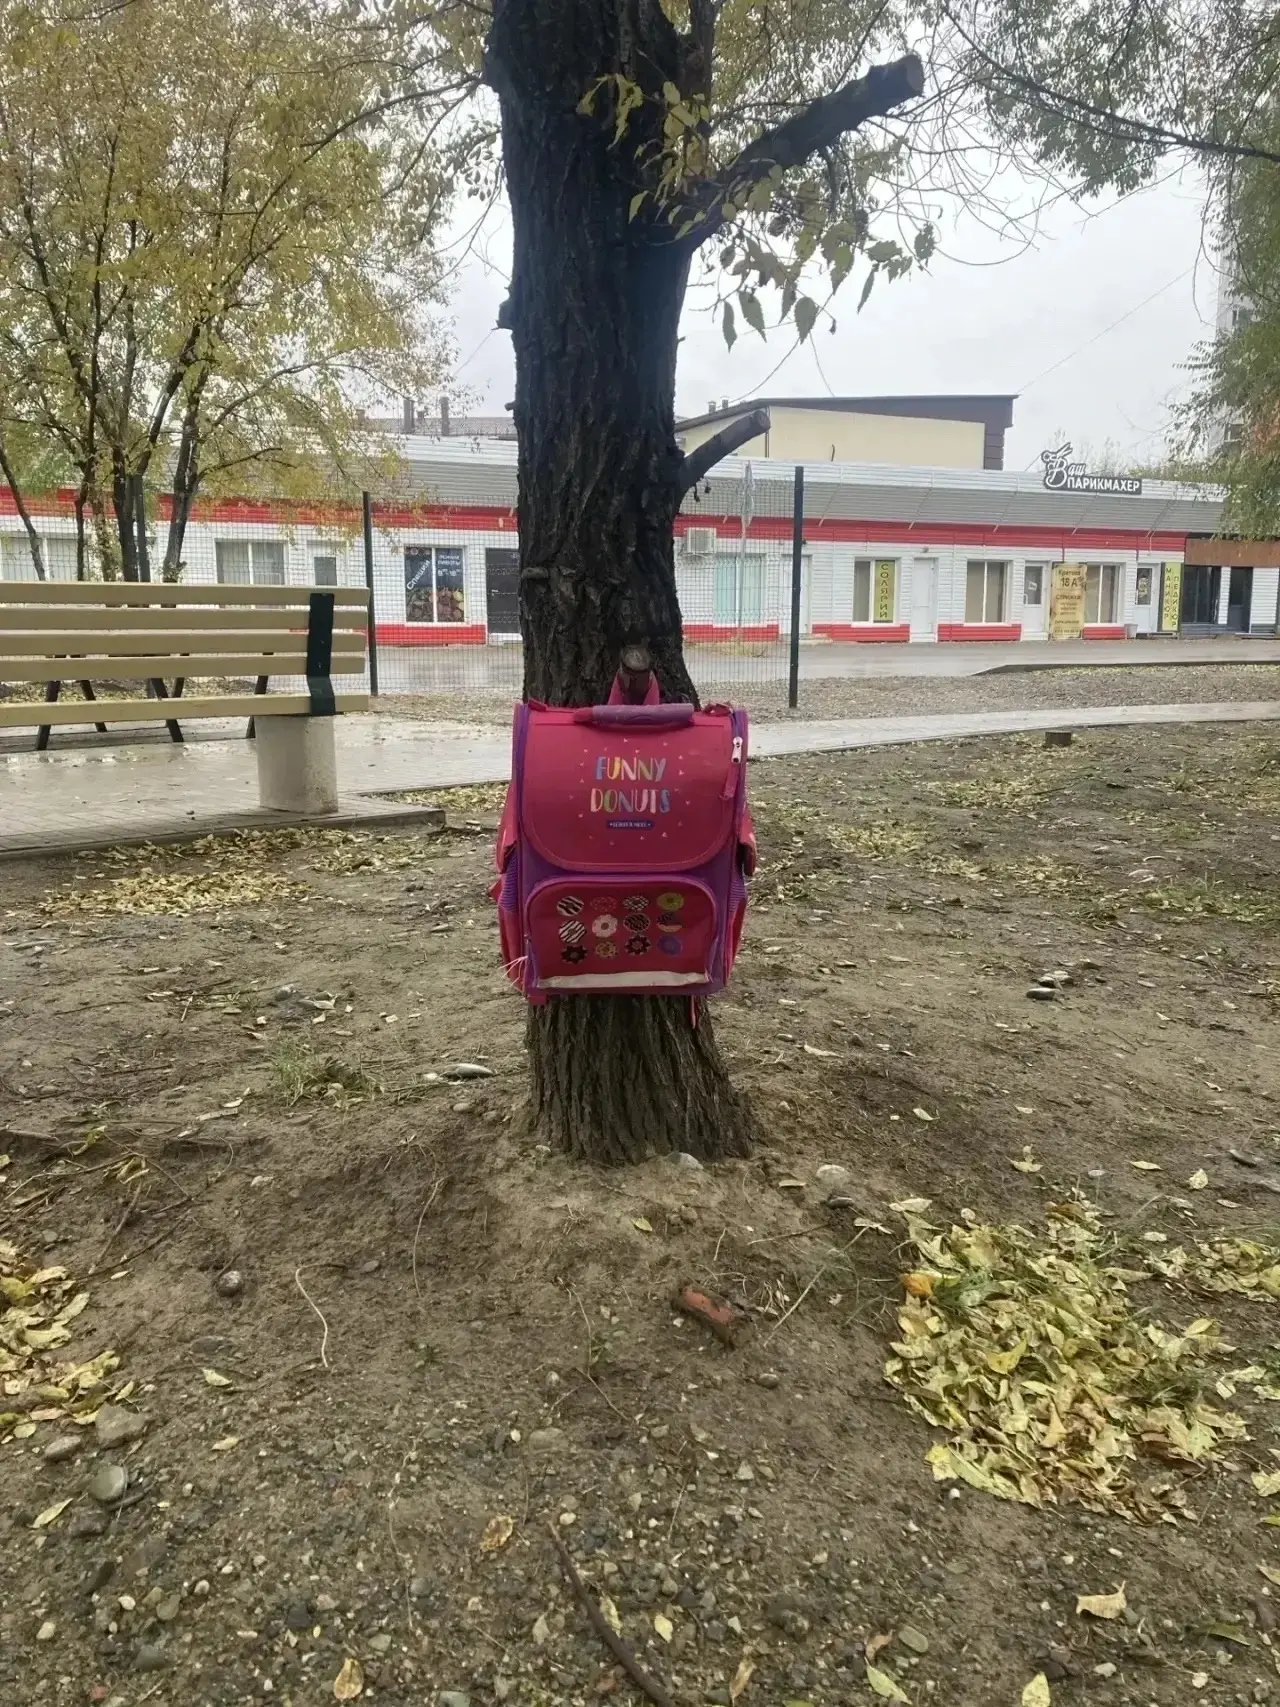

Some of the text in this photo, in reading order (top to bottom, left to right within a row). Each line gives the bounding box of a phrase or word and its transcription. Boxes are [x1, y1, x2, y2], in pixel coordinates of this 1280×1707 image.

[1043, 455, 1086, 488] Ваш
[1067, 476, 1140, 492] ПАРИКМАХЕР
[880, 563, 889, 618] СОЛЯРИЙ
[1060, 577, 1070, 588] 18
[595, 756, 667, 782] FUNNY
[590, 788, 671, 815] DONUTS
